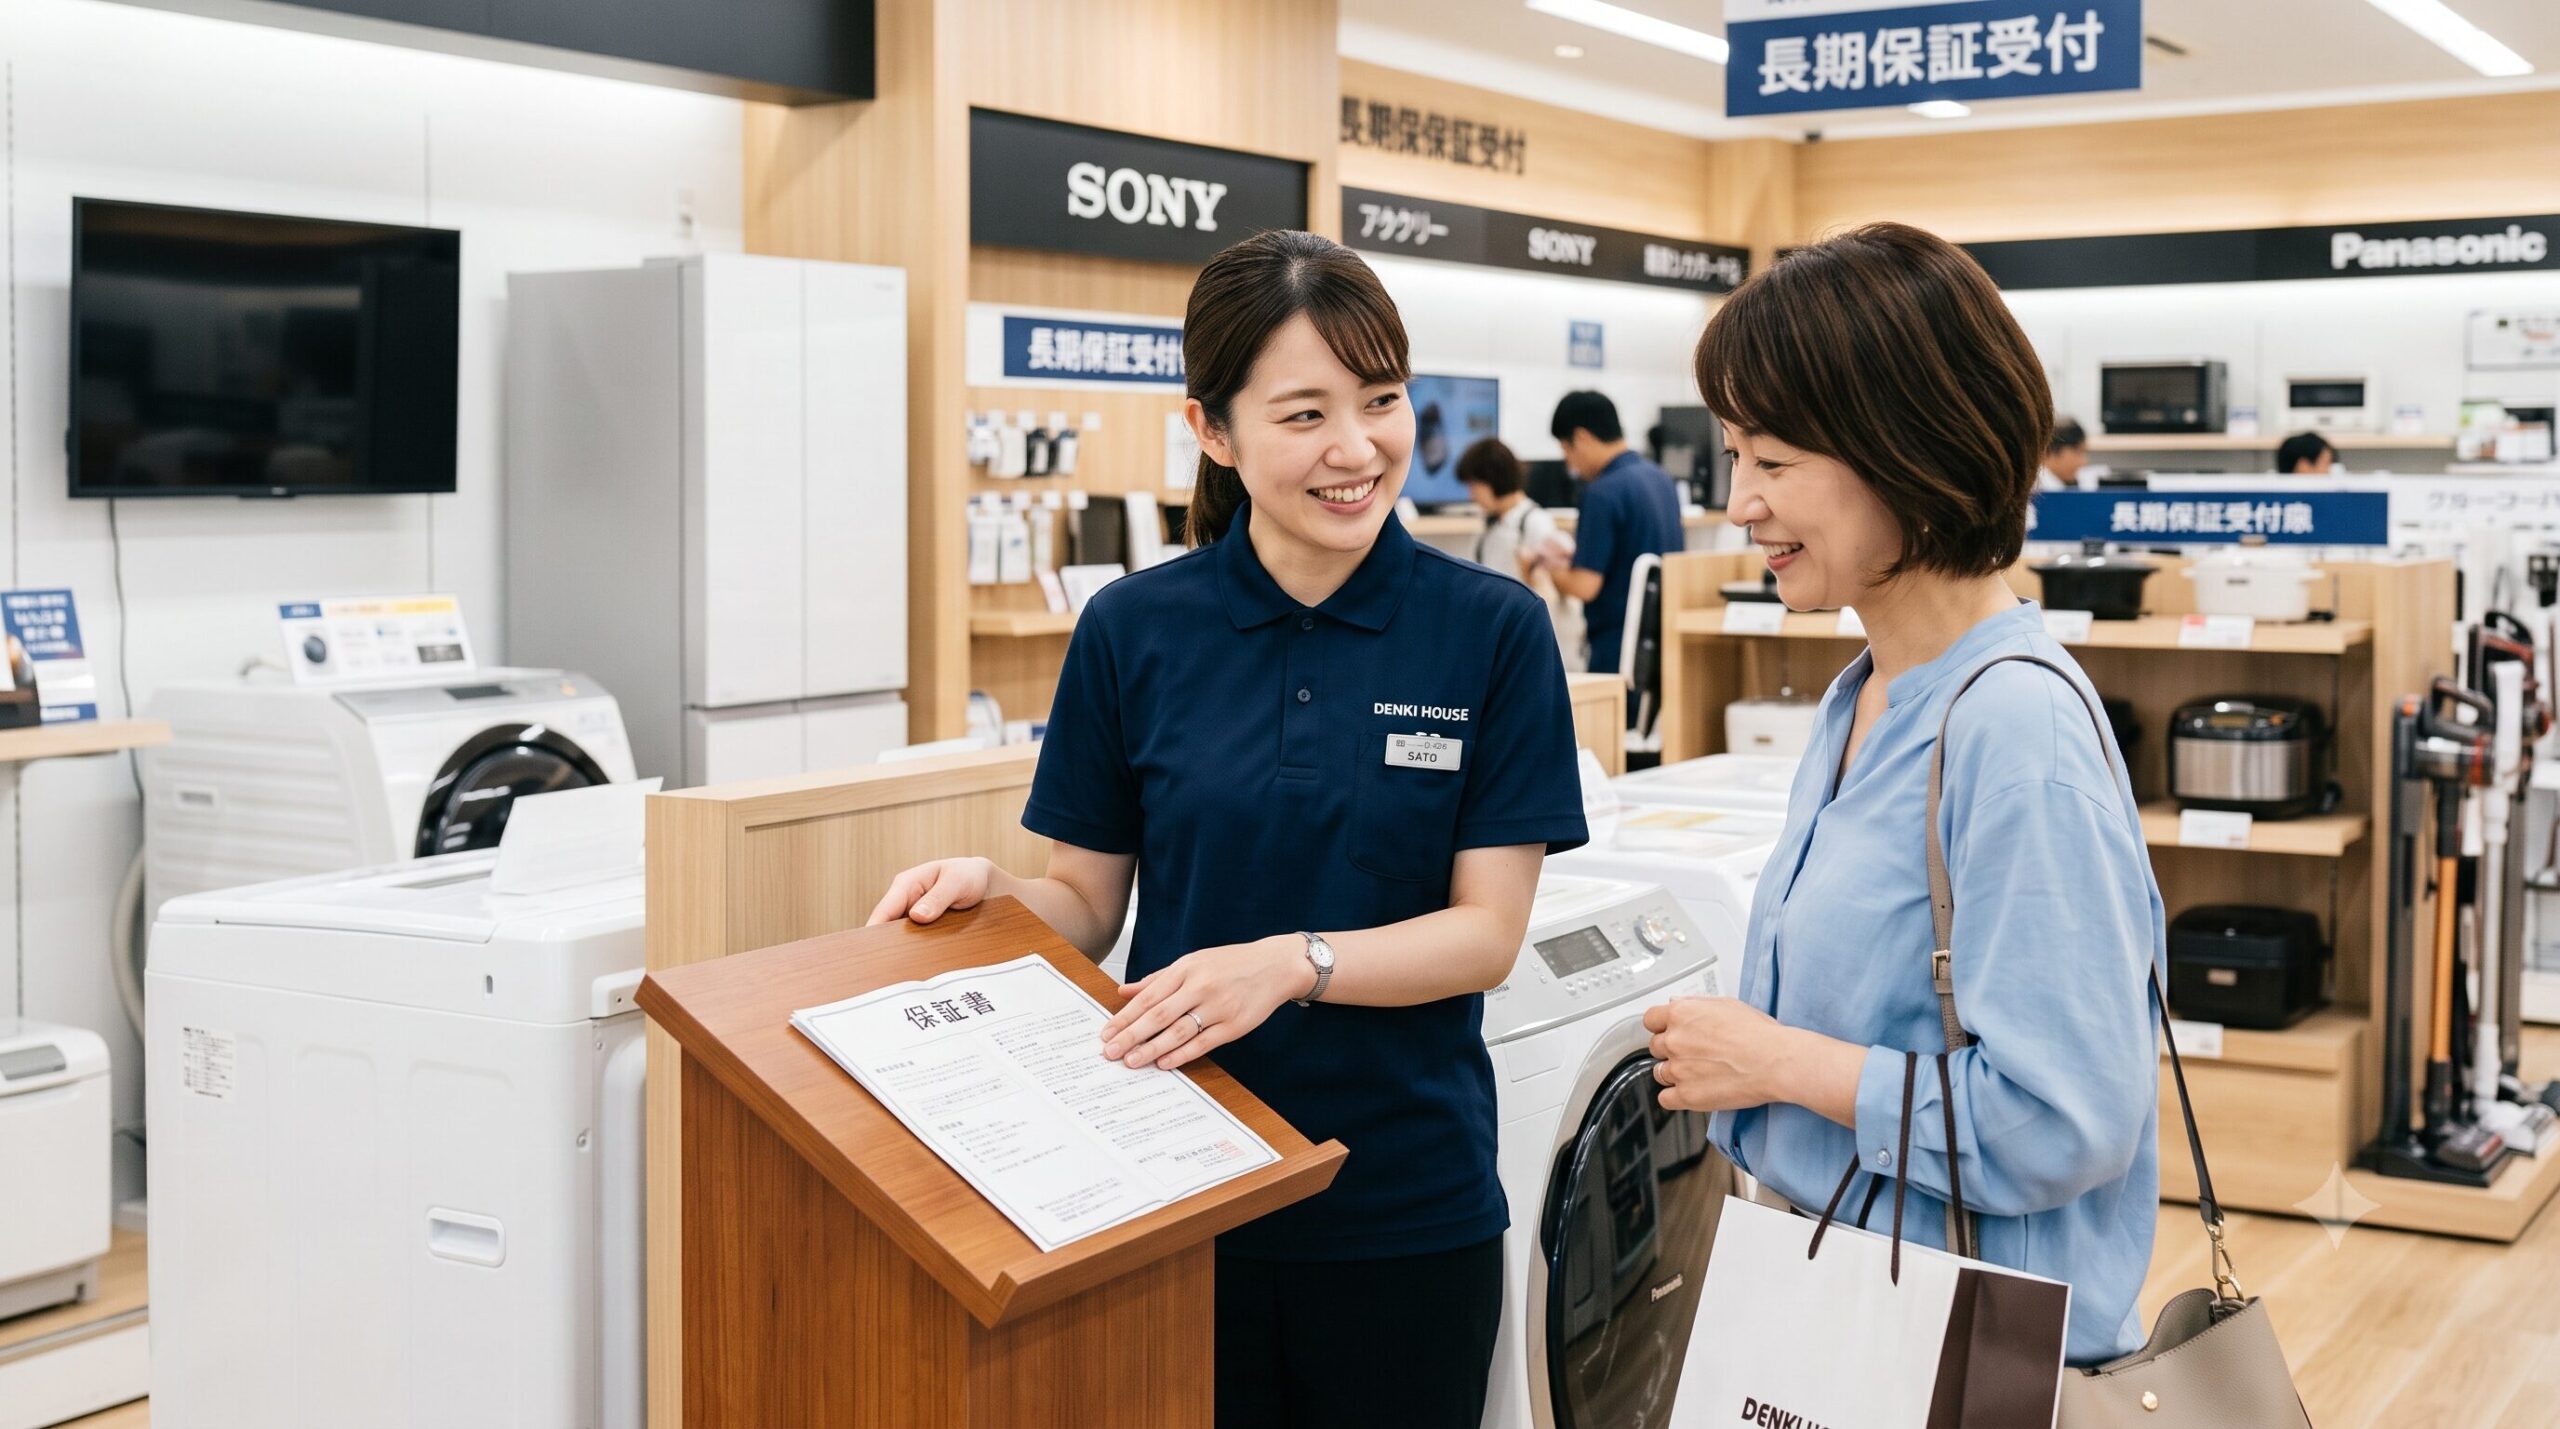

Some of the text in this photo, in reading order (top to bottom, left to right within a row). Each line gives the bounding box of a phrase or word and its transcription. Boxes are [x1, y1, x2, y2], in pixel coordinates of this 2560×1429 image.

[1758, 10, 2104, 96] 長期保証受付
[1067, 162, 1228, 232] SONY
[1528, 227, 1597, 266] SONY
[2331, 224, 2548, 270] Panasonic
[1028, 327, 1186, 377] 長期保証受付
[1374, 702, 1469, 721] DENKI HOUSE
[1407, 751, 1438, 763] SATO
[904, 991, 996, 1031] 保証書
